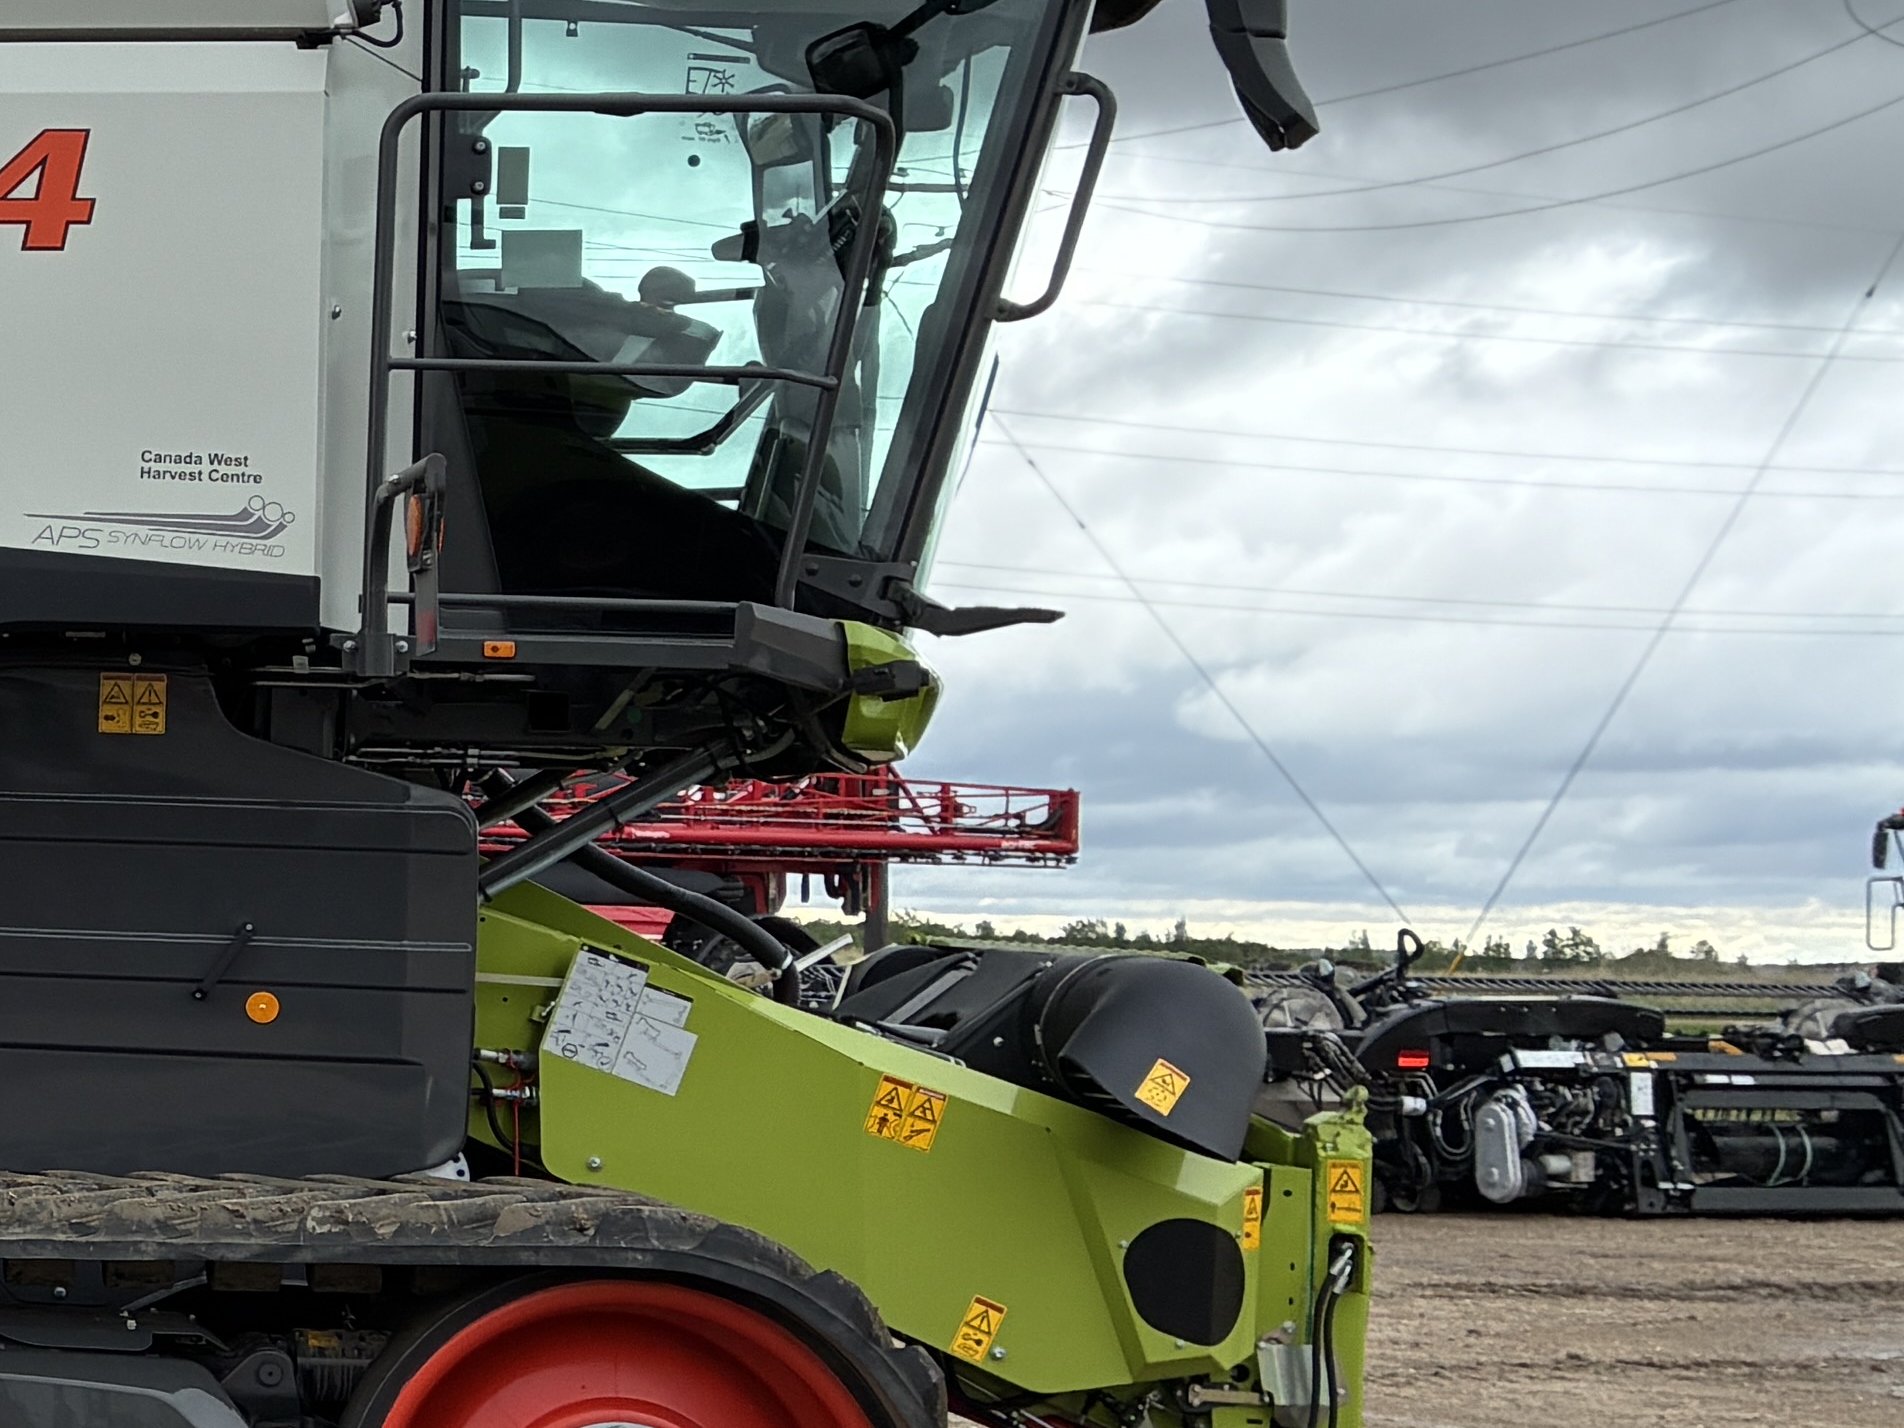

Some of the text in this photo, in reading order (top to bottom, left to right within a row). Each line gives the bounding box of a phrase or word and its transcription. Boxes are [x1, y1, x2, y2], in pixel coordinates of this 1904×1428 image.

[140, 449, 250, 469] Canada West
[139, 466, 263, 485] Harvest Centre
[31, 523, 286, 559] APS SYNFLOW HYBRID
